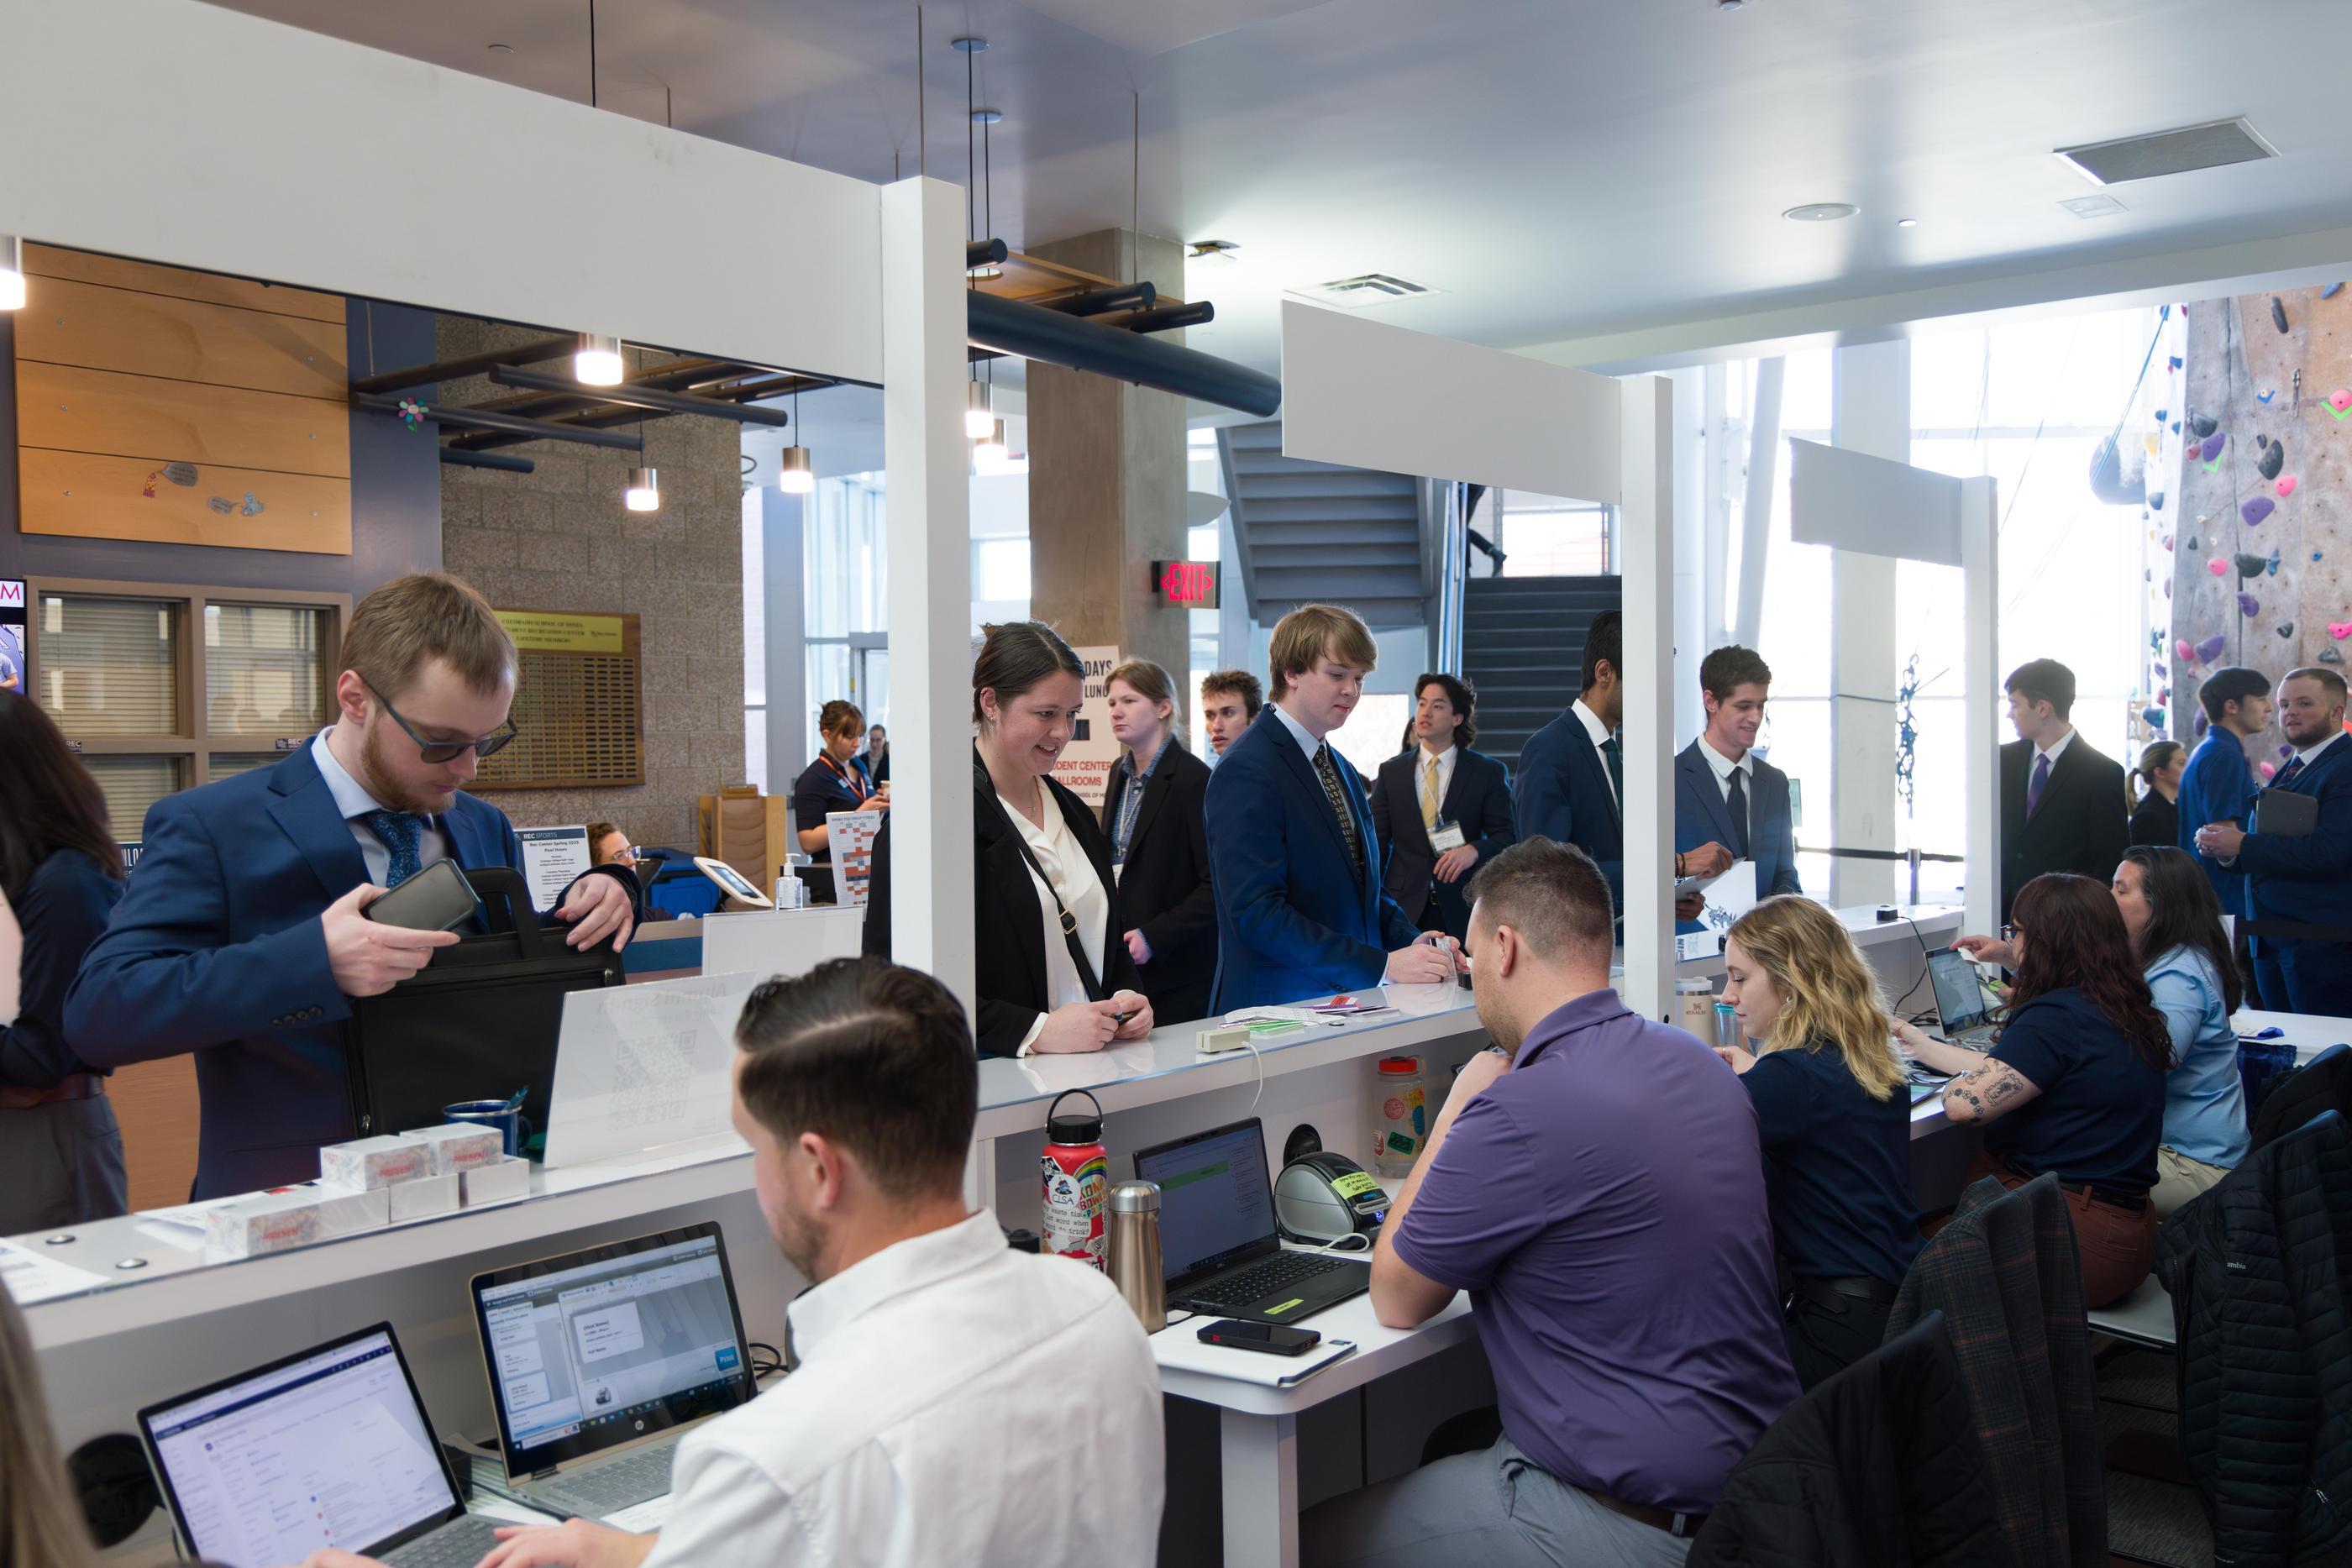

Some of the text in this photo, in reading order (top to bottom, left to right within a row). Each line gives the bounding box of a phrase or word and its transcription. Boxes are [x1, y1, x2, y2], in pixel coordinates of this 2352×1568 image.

[1168, 564, 1207, 601] EXIT
[1052, 1193, 1074, 1205] CISA
[719, 1354, 735, 1365] Print
